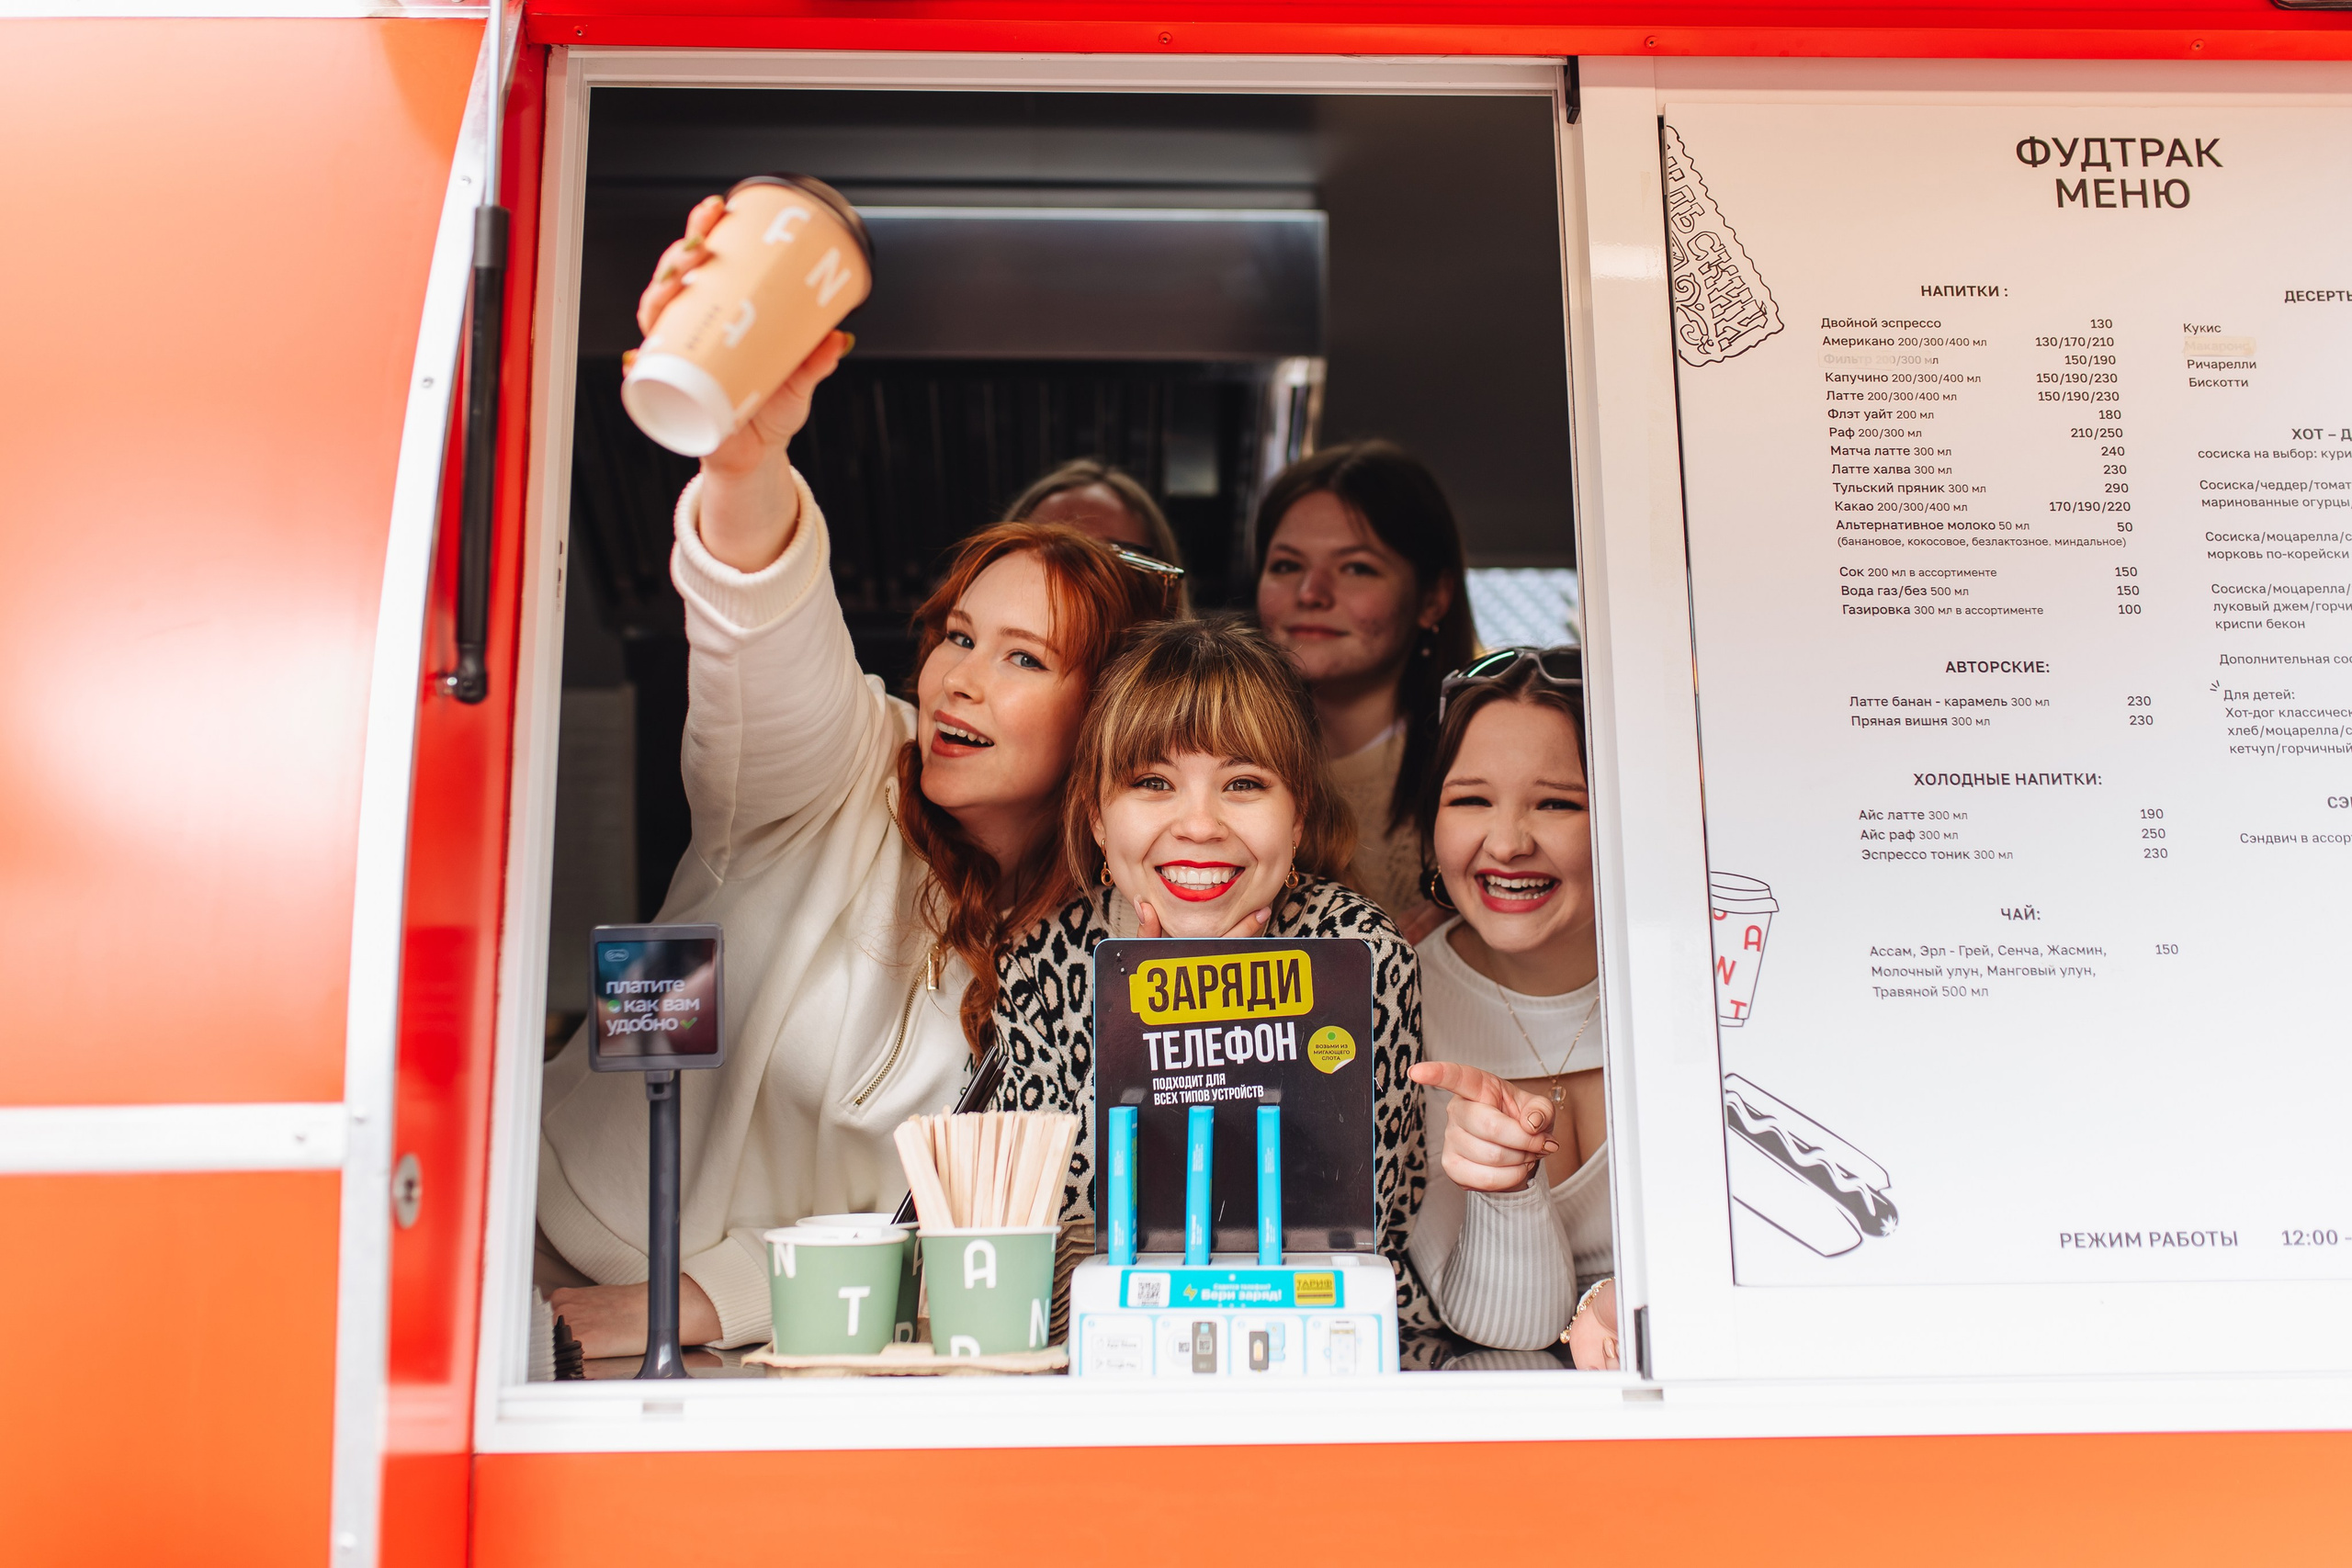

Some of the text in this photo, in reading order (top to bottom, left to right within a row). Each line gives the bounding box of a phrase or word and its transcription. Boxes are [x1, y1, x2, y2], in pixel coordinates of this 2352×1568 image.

[2016, 135, 2224, 173] ФУДТРАК
[2055, 177, 2191, 209] МЕНЮ
[1920, 285, 2000, 298] НАПИТКИ
[1820, 317, 2113, 331] Двойной эспрессо 130
[2183, 322, 2222, 336] Кукис
[1822, 335, 2115, 350] Американо 200/300/400 130/170/210
[2064, 355, 2117, 367] 150/190
[2187, 358, 2257, 372] Ричарелли
[1825, 371, 2118, 386] Капучино 200/300/400 150/190/230
[2188, 377, 2249, 388] Бискотти
[1826, 389, 2120, 404] Латте 200/300/400 150/190/230
[1827, 408, 2122, 422] Флэт уайт 200 180
[1828, 426, 2123, 441] Раф 200/300 210/250
[2290, 428, 2324, 441] ХОТ
[1830, 445, 2125, 457] Матча латте 300 240
[2197, 447, 2352, 461] сосиска на выбор: кури
[1831, 463, 2127, 475] Латте халва 300 230
[1832, 481, 2129, 496] Тульский пряник 300 290
[2199, 479, 2352, 492] Сосиска/чеддер/томат
[1834, 501, 2132, 514] Какао 200/300/400 170/190/220
[2201, 499, 2300, 510] маринованные
[1836, 519, 2133, 533] Альтернативное молоко 50 50
[1837, 536, 1905, 548] (банановое,
[1907, 538, 1969, 547] кокосовое,
[2054, 536, 2127, 548] миндальное)
[2207, 547, 2350, 562] морковь по-корейски
[1839, 566, 2138, 580] Сок 200 ассортименте 150
[1840, 584, 2140, 599] Вода газ/без 500 150
[1842, 604, 2142, 617] Газировка 300 ассортименте 100
[2212, 600, 2270, 615] луковый
[2214, 618, 2306, 632] криспи бекон
[1945, 660, 2051, 673] АВТОРСКИЕ:
[2219, 653, 2331, 667] Дополнительная
[1849, 695, 2152, 710] Латте банан карамель 300 230
[2222, 688, 2295, 702] Для детей:
[2224, 706, 2276, 720] Хот-дог
[1850, 715, 2154, 729] Пряная вишня 300 230
[1913, 773, 2102, 788] ХОЛОДНЫЕ НАПИТКИ:
[1858, 807, 2165, 821] Айс латте 300 190
[1860, 828, 2166, 843] Айс раф 300 мл 250
[2239, 832, 2298, 845] Сэндвич
[1861, 847, 2168, 863] Эспрессо тоник 300 230
[2000, 904, 2041, 921] ЧАЙ:
[1870, 943, 2179, 960] Ассам, Эрл Грей, Сенча, Жасмин, 150
[1871, 964, 2097, 980] Молочный улун, Манговый улун,
[605, 979, 685, 995] платите
[1147, 958, 1302, 1012] ЗАРЯДИ
[1871, 985, 1989, 1000] Травяной 500 мл
[623, 998, 701, 1013] как вам
[605, 1013, 679, 1036] удобно
[1142, 1021, 1297, 1071] ТЕЛЕФОН
[1152, 1073, 1227, 1091] ПОДХОДИТ ДЛЯ
[1154, 1084, 1265, 1106] ВСЕХ ТИПОВ УСТРОЙСТВ
[2059, 1229, 2338, 1249] РЕЖИМ РАБОТЫ 12:00
[963, 1239, 997, 1290] A
[837, 1286, 871, 1337] T
